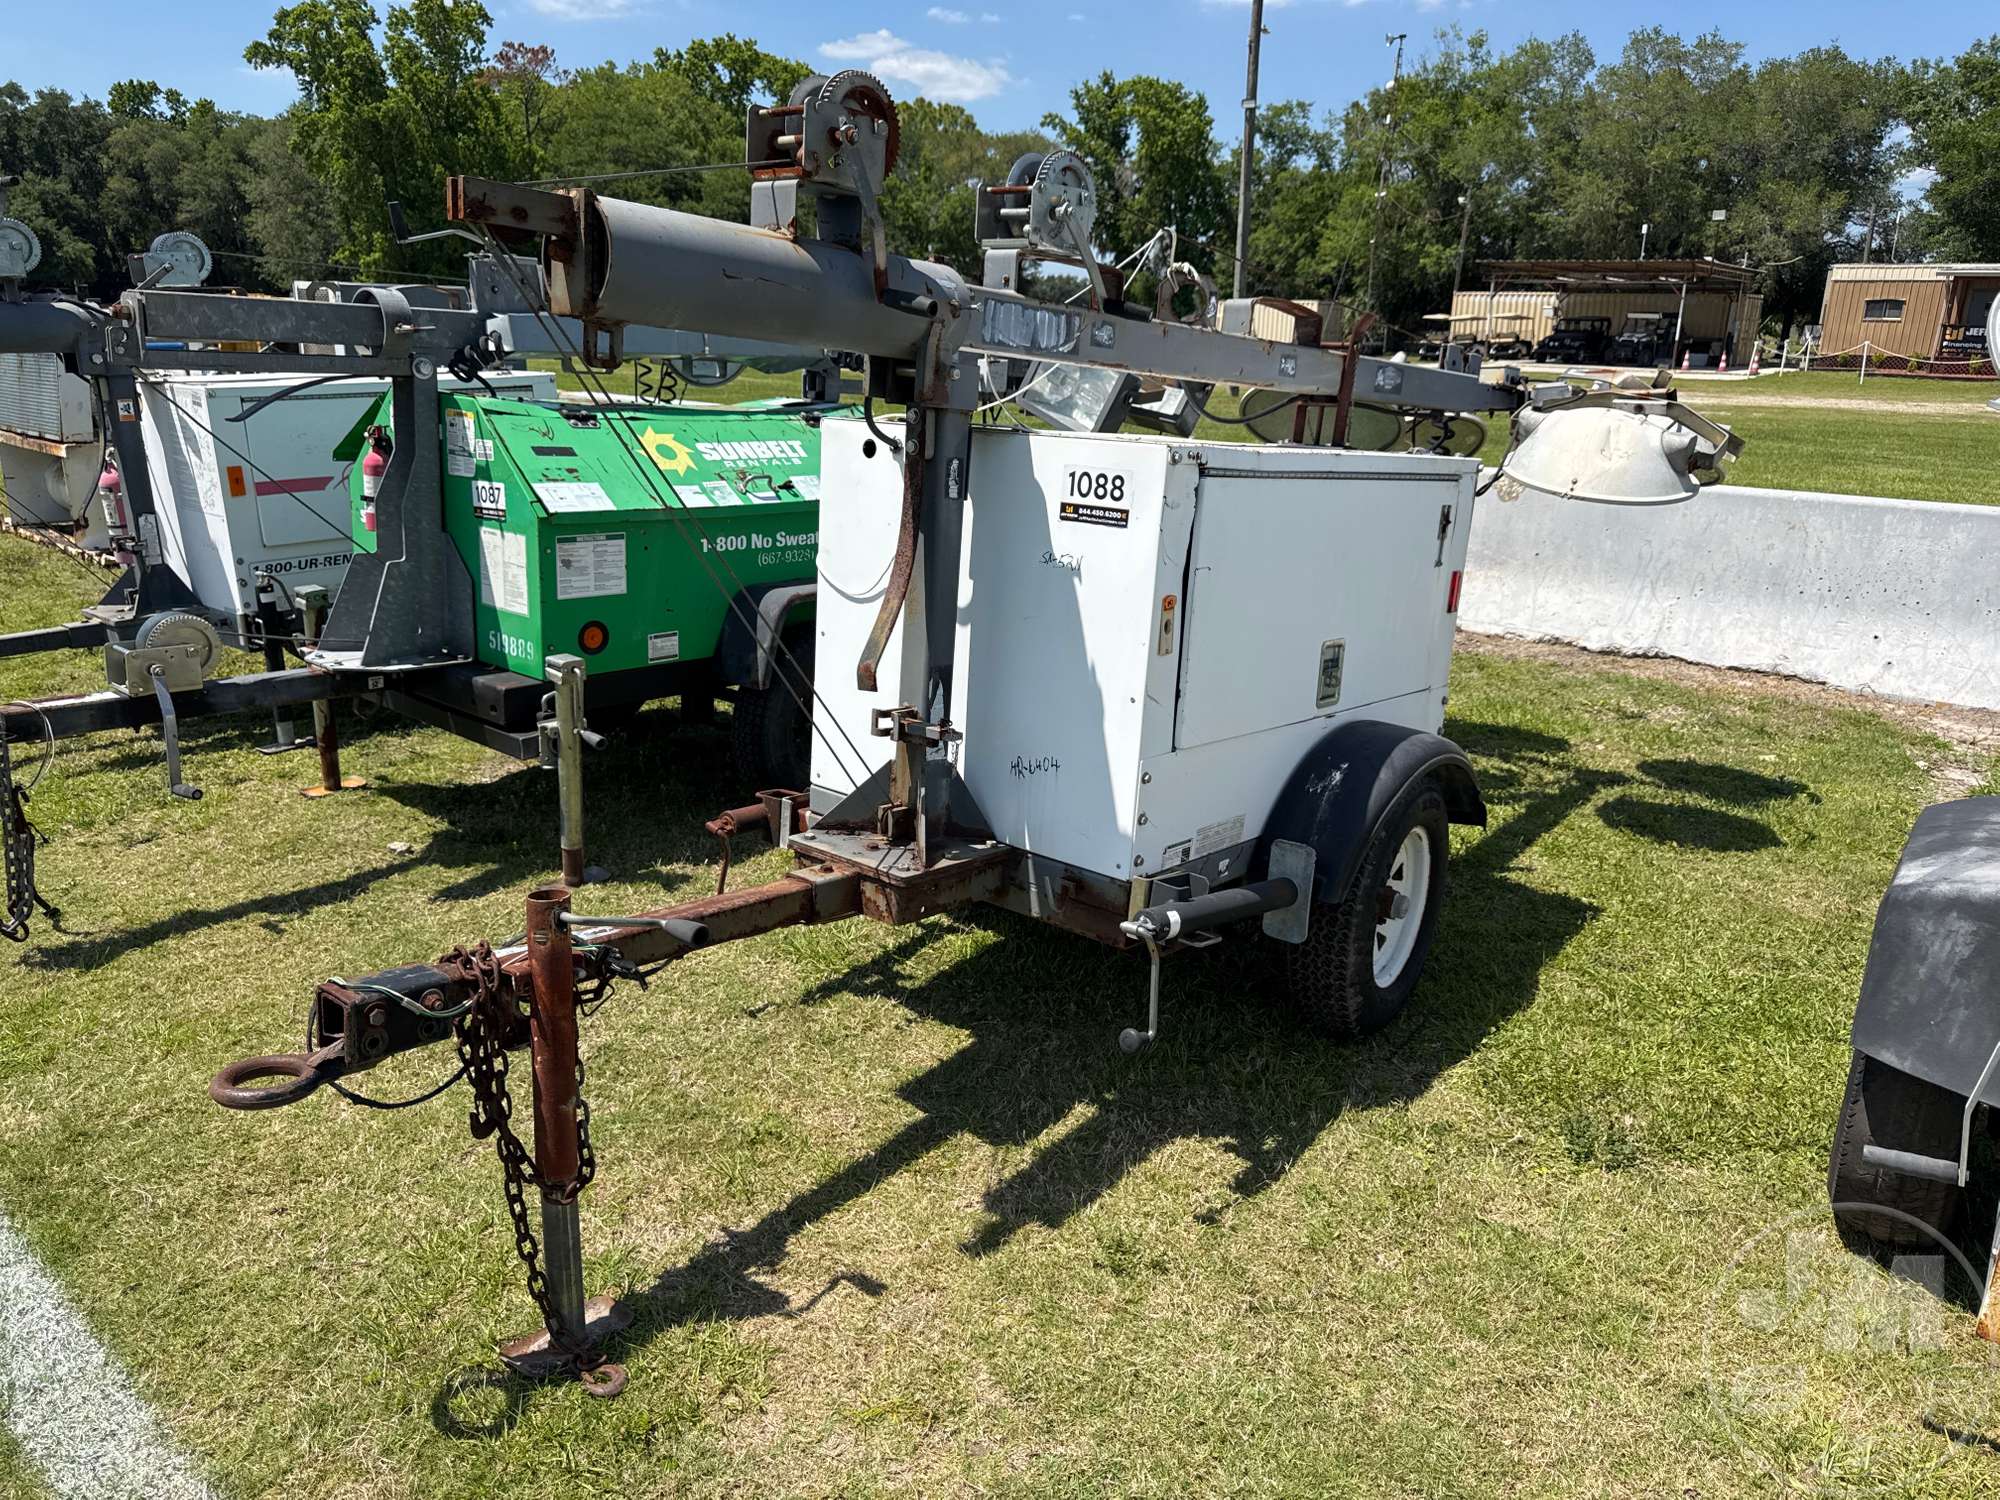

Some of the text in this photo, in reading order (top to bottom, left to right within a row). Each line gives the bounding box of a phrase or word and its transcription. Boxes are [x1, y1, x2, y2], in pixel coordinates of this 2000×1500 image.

[694, 439, 809, 461] SUNBELT
[723, 457, 803, 468] RENTALS
[475, 485, 501, 505] 1087
[1068, 470, 1125, 502] 1088
[1078, 507, 1122, 520] 844.450.6200
[700, 534, 748, 553] 1-800
[750, 532, 773, 549] No
[488, 630, 535, 662] 519889
